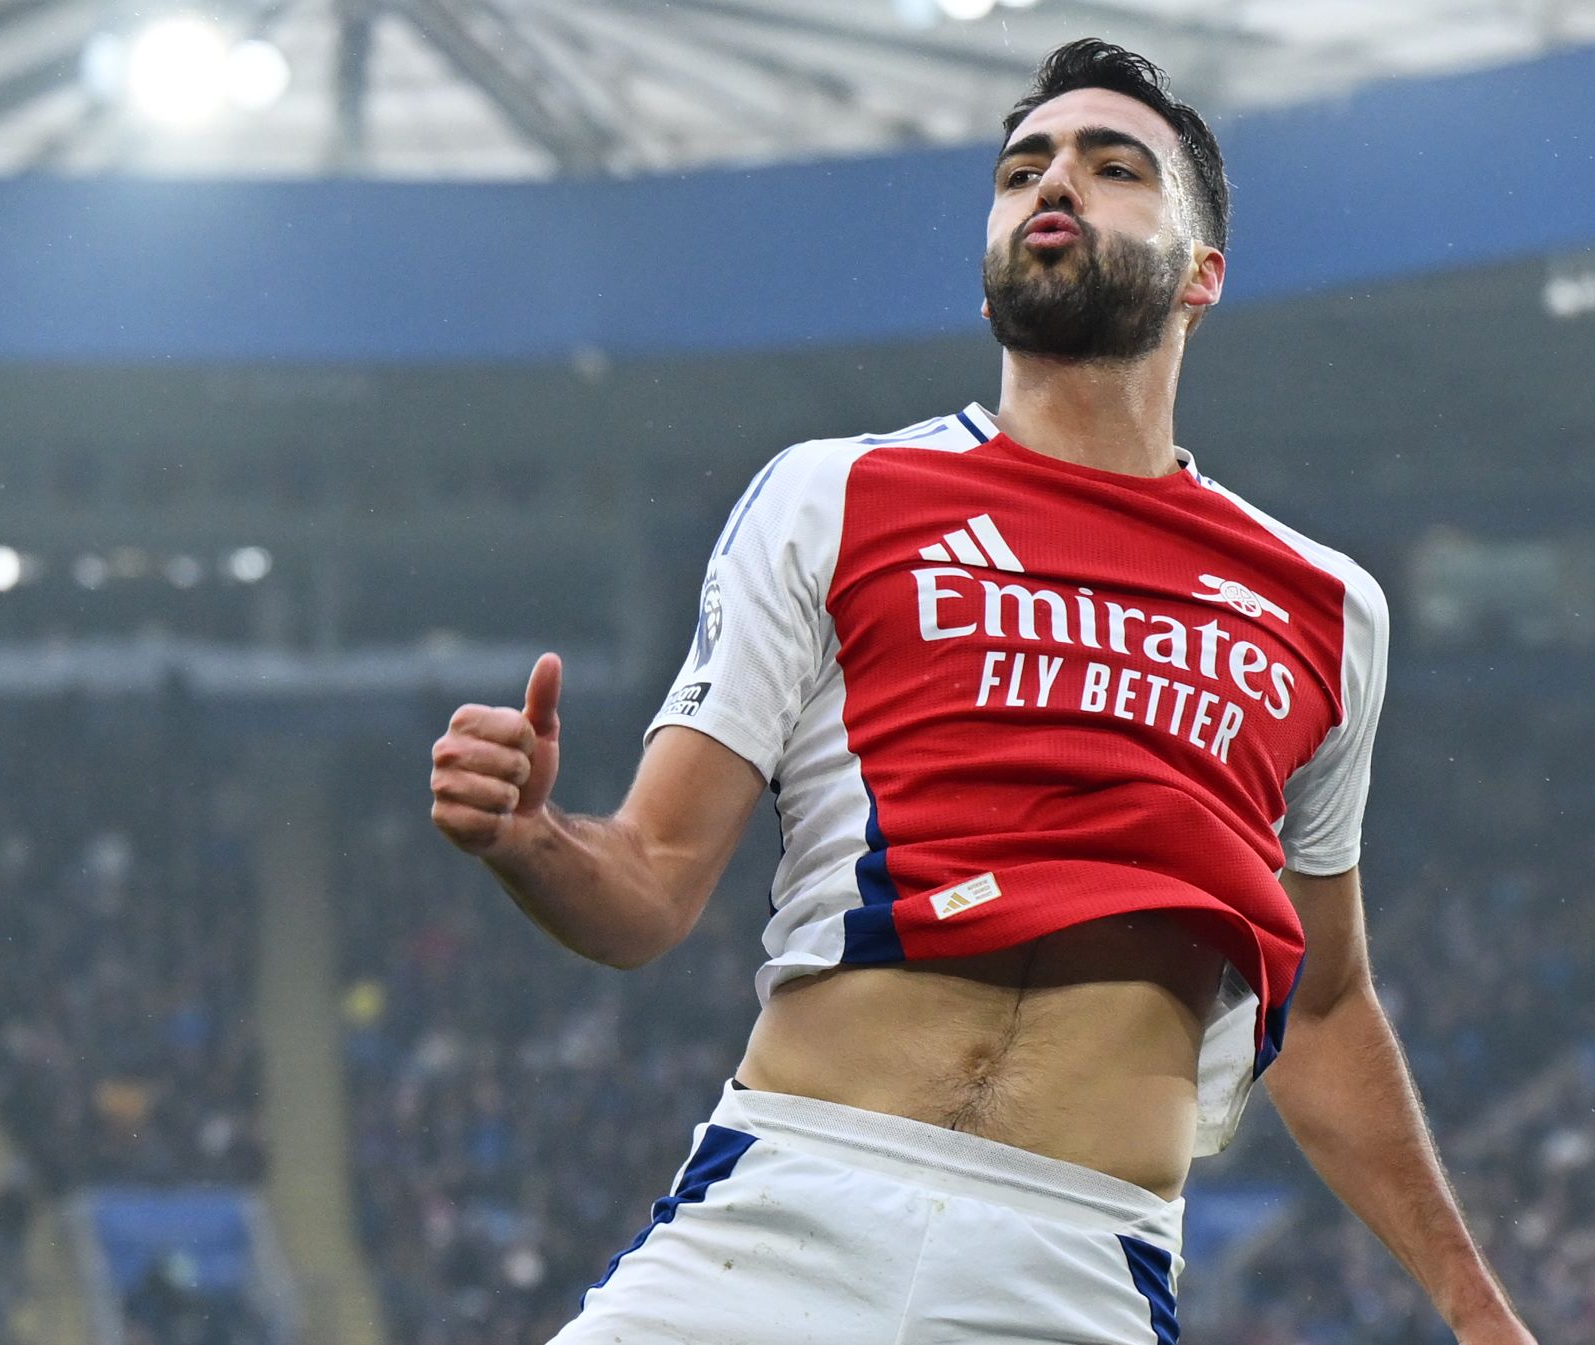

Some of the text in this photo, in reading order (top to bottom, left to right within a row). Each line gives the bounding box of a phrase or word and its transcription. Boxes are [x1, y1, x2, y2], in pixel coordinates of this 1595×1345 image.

[910, 566, 1295, 720] Emirates
[975, 651, 1244, 764] FLY BETTER
